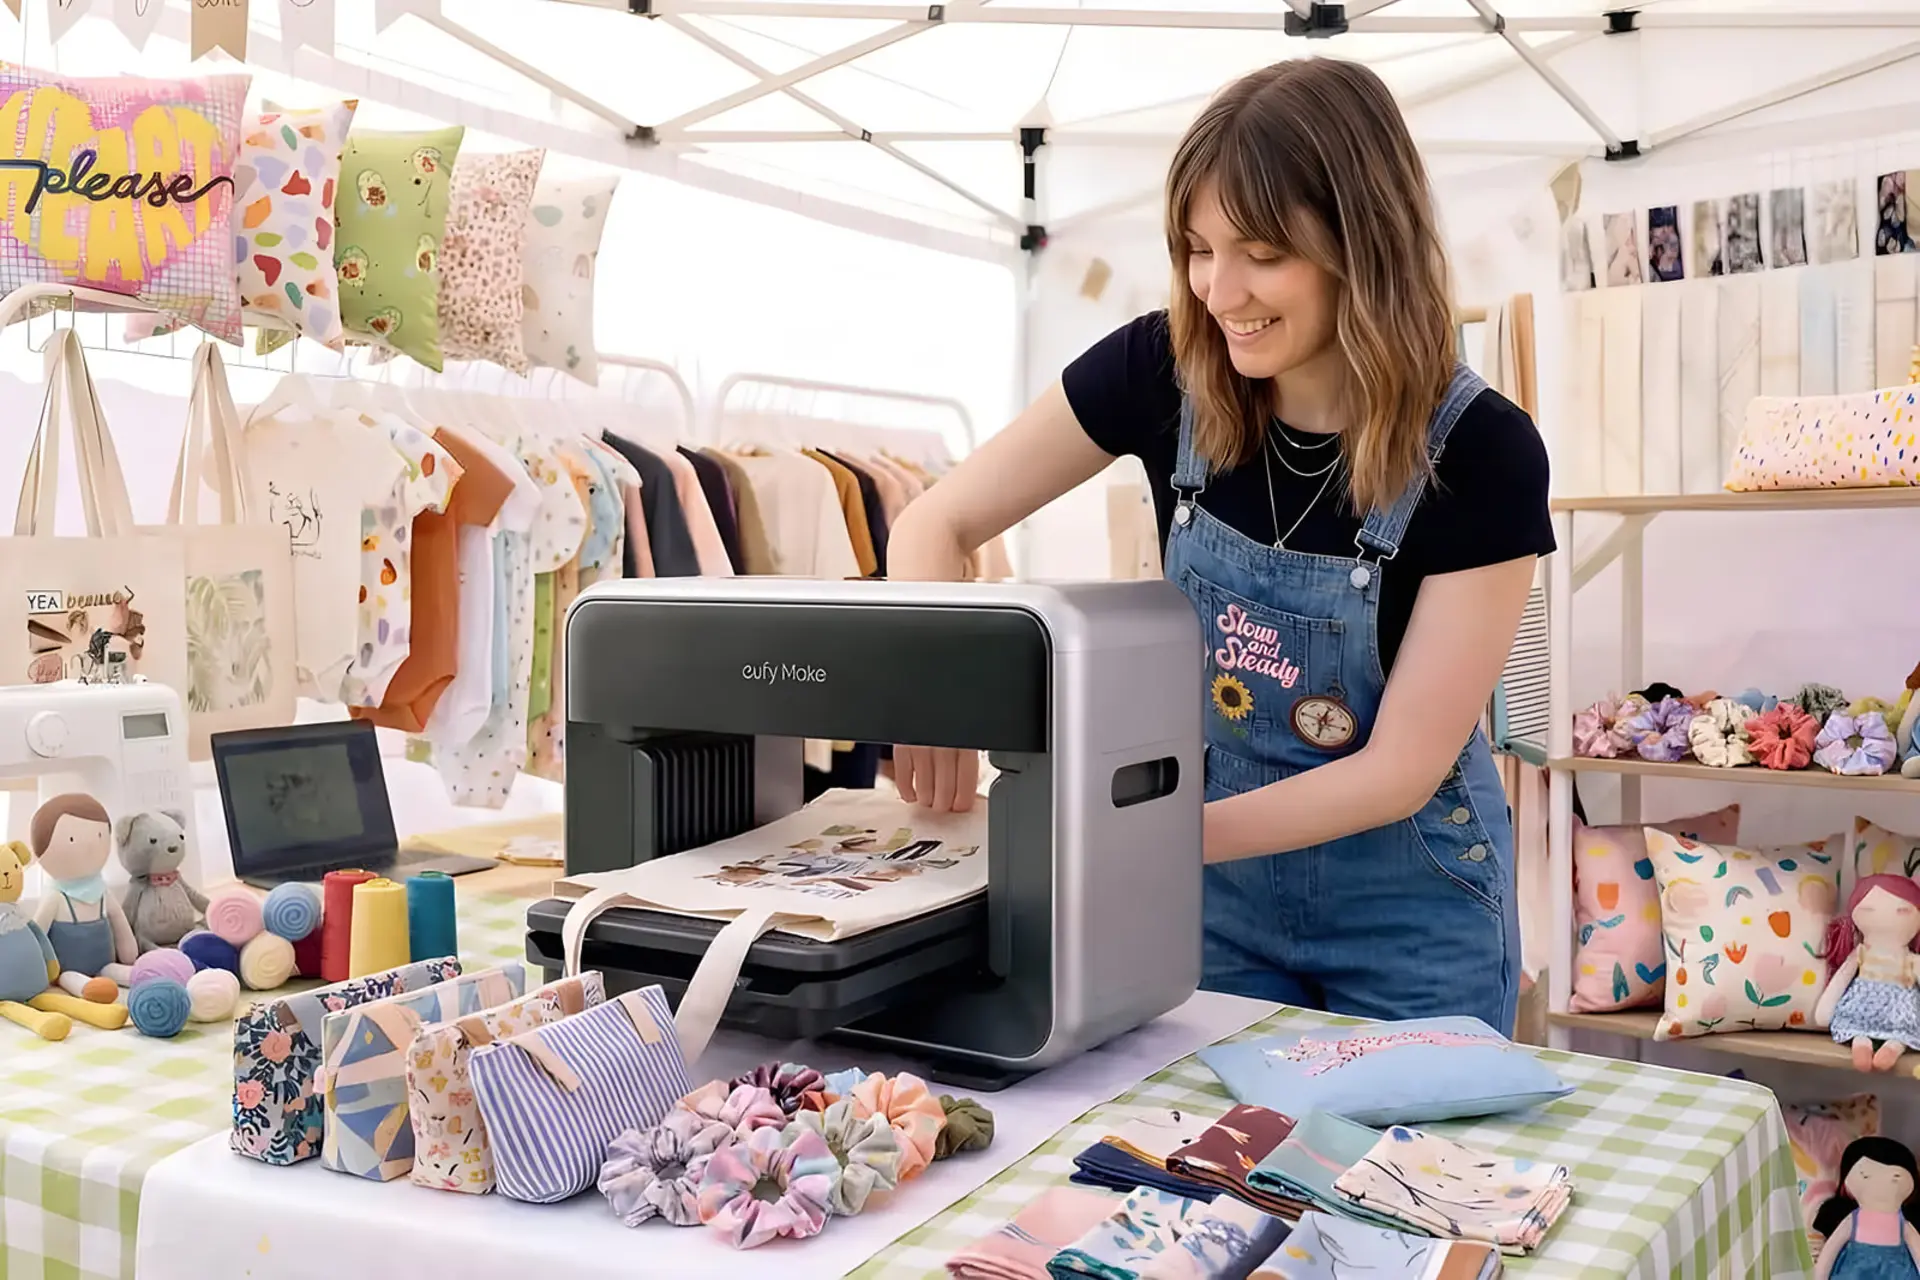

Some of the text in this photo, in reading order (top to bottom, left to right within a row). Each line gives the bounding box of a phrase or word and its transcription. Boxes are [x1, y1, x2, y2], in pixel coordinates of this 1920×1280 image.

[2, 149, 235, 215] please
[1217, 604, 1278, 645] Slow
[1215, 637, 1300, 688] Steady
[1247, 640, 1282, 658] and
[742, 661, 779, 685] eufy
